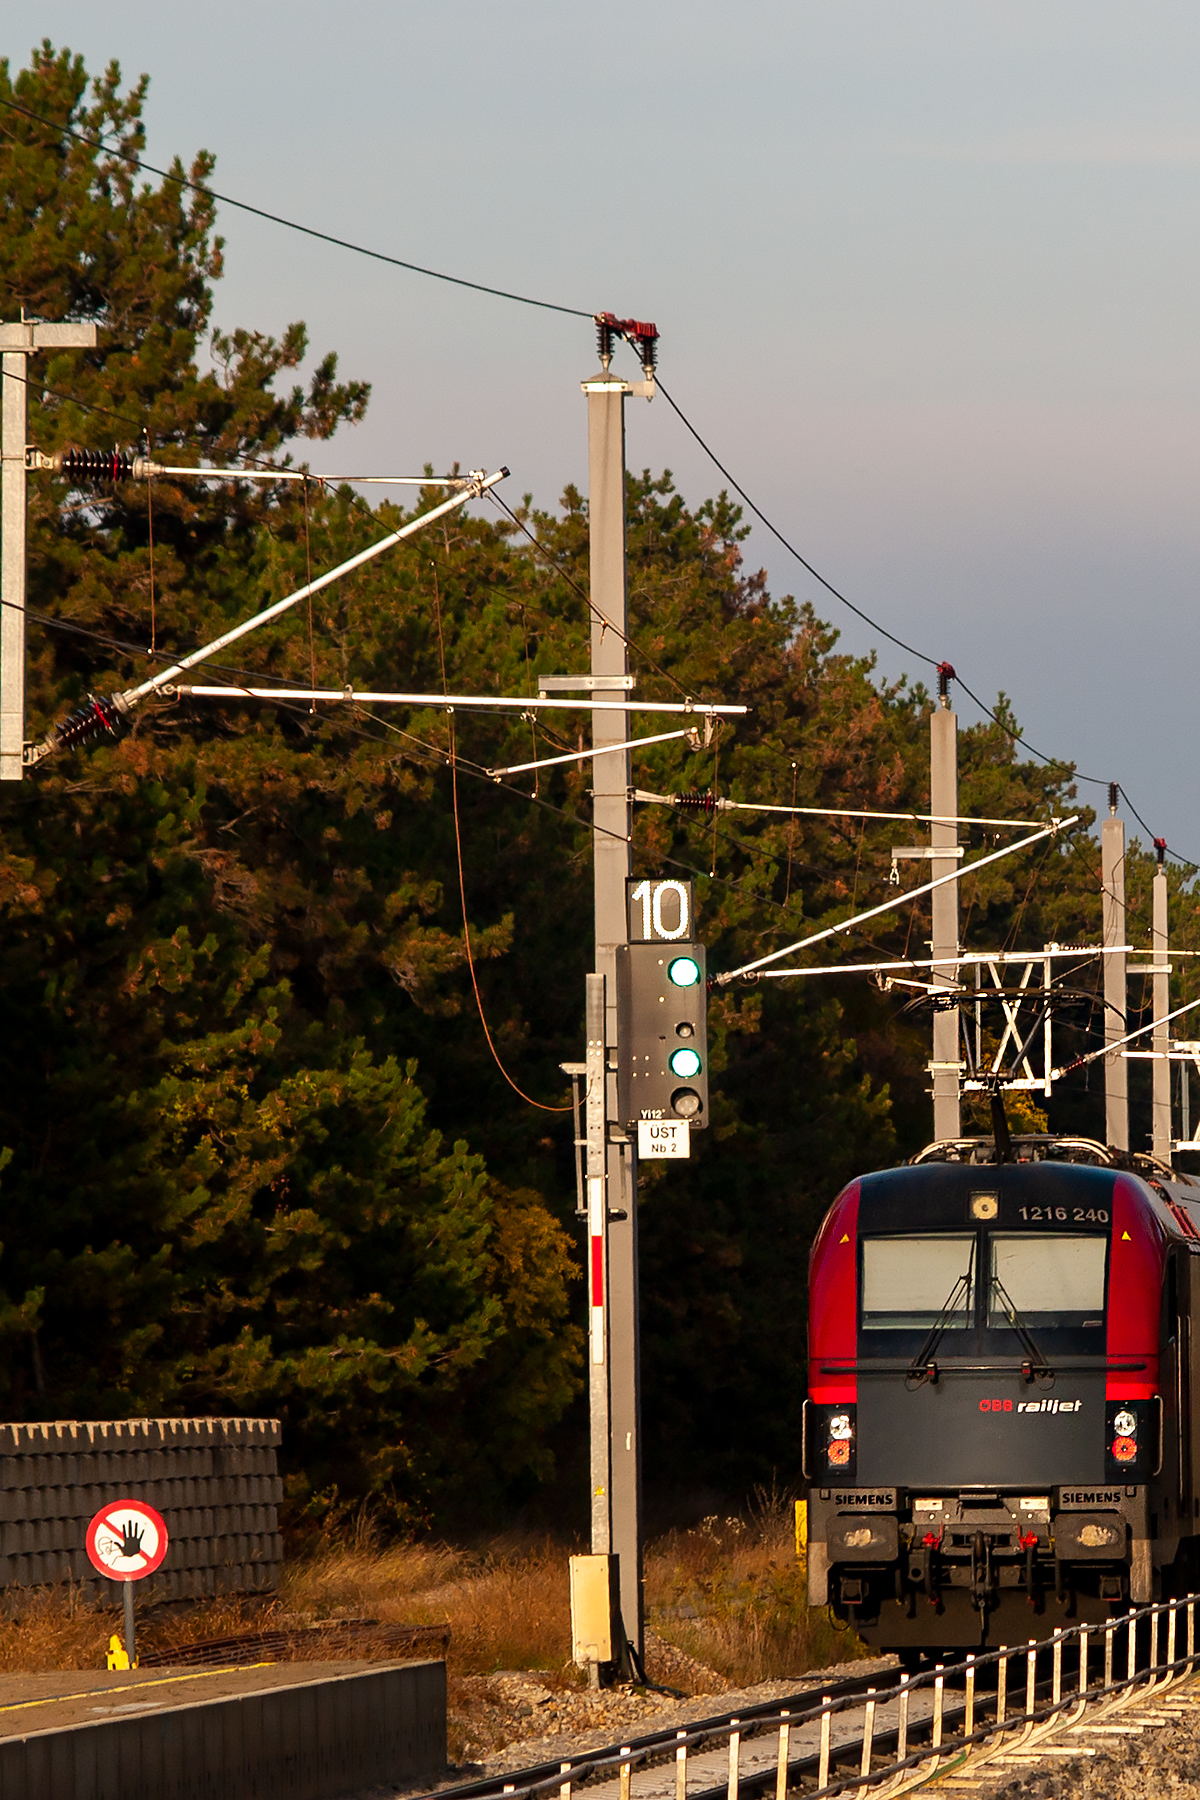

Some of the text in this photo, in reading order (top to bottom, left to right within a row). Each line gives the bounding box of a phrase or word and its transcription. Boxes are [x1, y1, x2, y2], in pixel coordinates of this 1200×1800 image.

[631, 879, 689, 941] 10
[650, 1124, 677, 1138] ÜST
[651, 1143, 677, 1153] Nb 2
[1018, 1206, 1109, 1223] 1216 240
[1017, 1399, 1082, 1414] railjet
[835, 1494, 893, 1505] SIEMENS
[1062, 1492, 1121, 1503] SIEMENS
